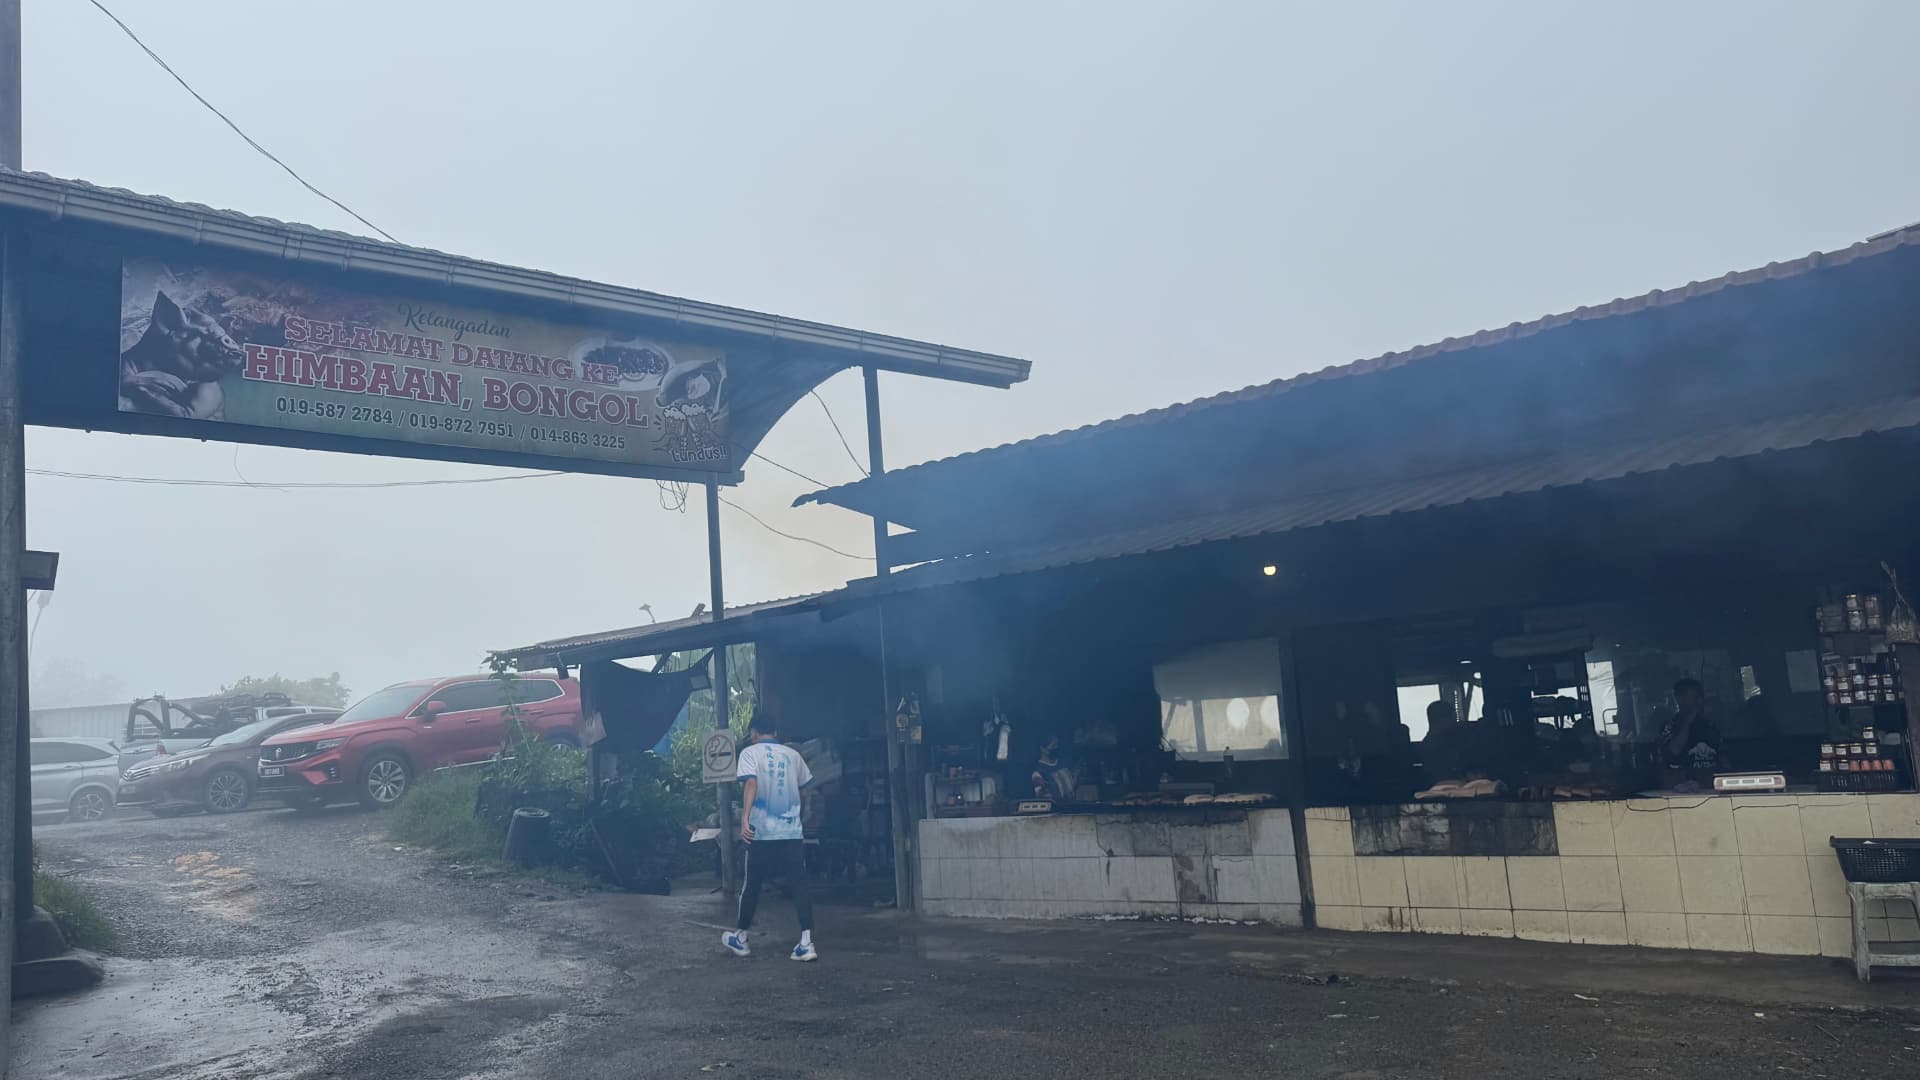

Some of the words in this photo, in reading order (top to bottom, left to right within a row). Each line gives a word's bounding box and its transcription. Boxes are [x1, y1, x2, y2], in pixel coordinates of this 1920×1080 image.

[284, 316, 444, 363] SELAMAT
[450, 342, 575, 381] DATANG
[580, 361, 620, 387] KE
[402, 305, 512, 341] Kelangadan
[243, 343, 473, 412] HIMBAAN,
[482, 376, 649, 429] BONGOL
[276, 397, 346, 419] 019-587
[351, 406, 393, 424] 2784
[409, 413, 473, 434] 019-872
[478, 421, 514, 437] 7951
[530, 427, 588, 445] 014-863
[592, 434, 626, 449] 3225
